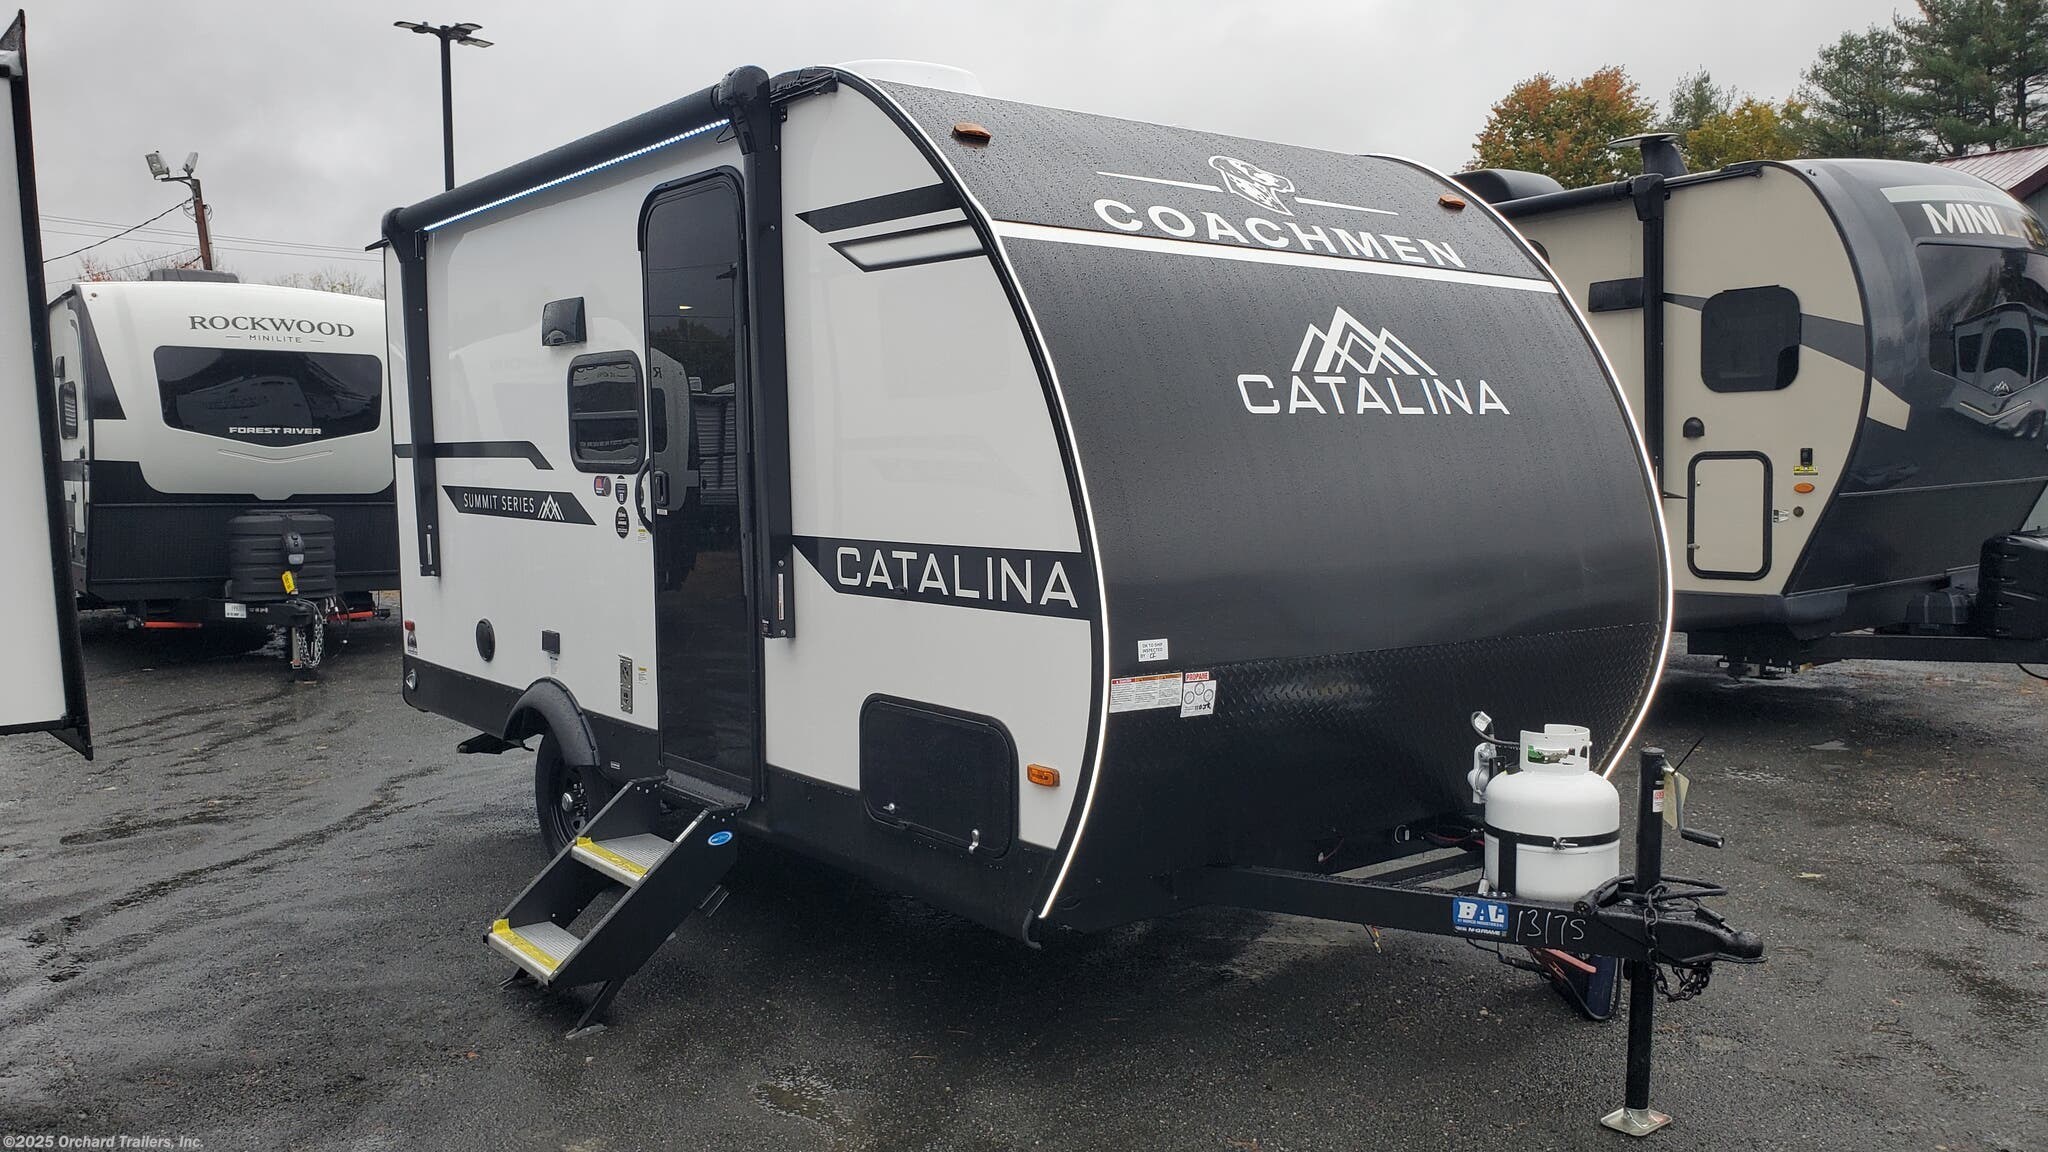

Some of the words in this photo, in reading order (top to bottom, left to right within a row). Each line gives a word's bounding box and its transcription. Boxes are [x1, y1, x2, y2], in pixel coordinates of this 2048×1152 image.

[1093, 199, 1466, 269] COACHMEN
[189, 315, 355, 338] ROCKWOOD
[249, 334, 302, 344] MINILITE
[1237, 374, 1511, 415] CATALINA
[229, 426, 281, 434] FOREST
[283, 427, 322, 435] RIVER
[463, 492, 498, 509] SUMMIT
[501, 495, 535, 513] SERIES
[836, 546, 1079, 609] CATALINA
[1186, 672, 1208, 680] PROPANE
[1458, 901, 1505, 923] BAL
